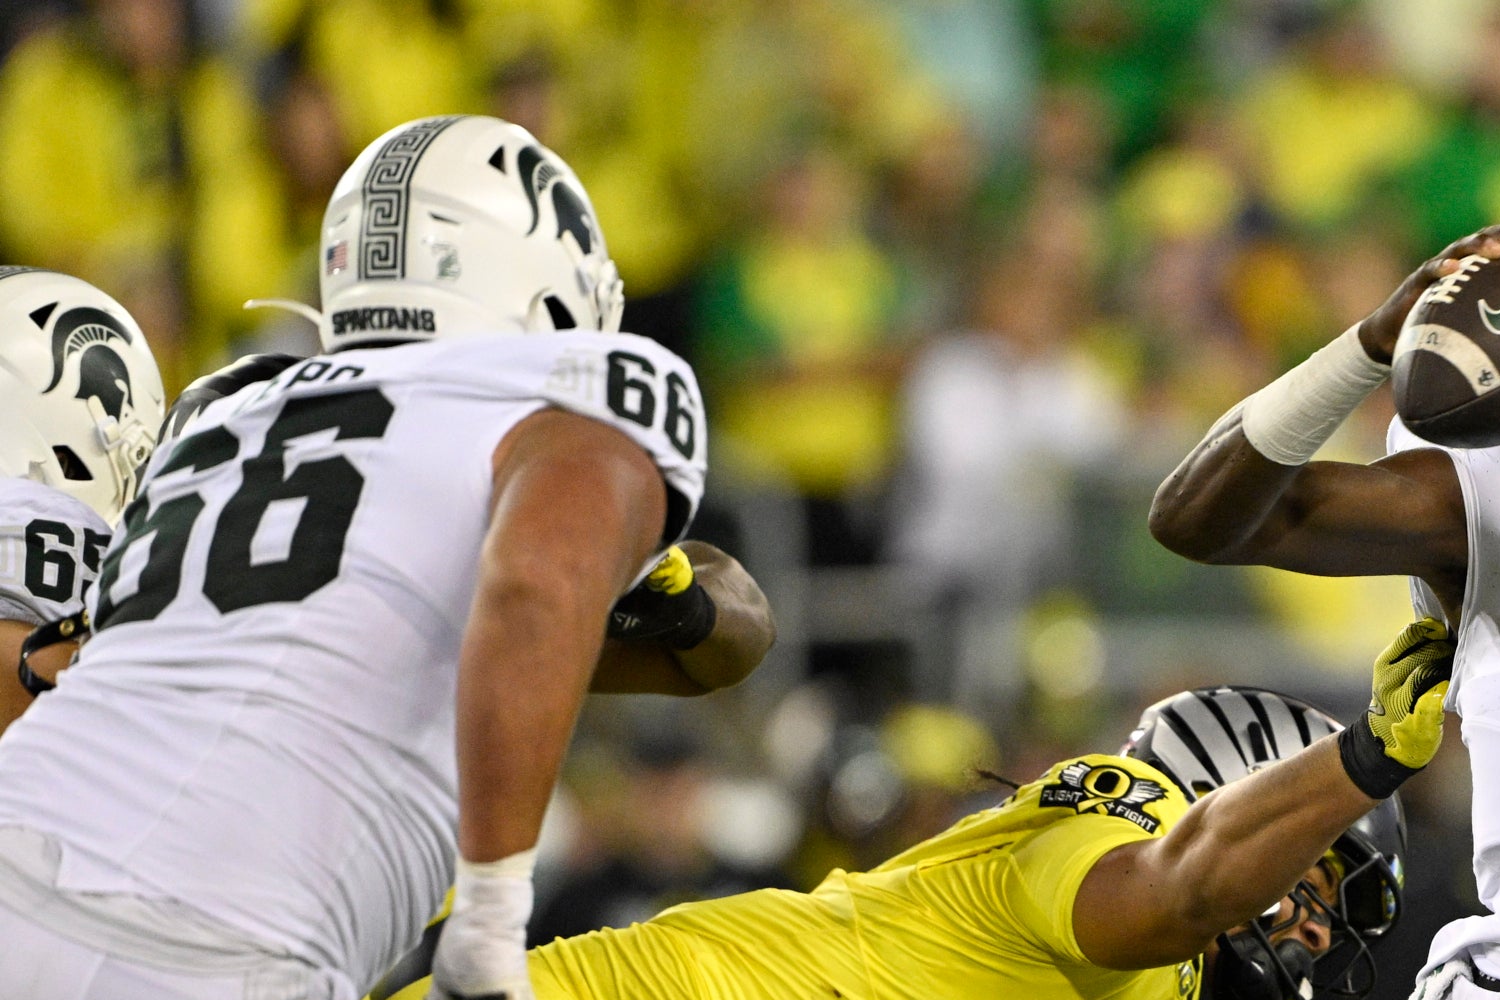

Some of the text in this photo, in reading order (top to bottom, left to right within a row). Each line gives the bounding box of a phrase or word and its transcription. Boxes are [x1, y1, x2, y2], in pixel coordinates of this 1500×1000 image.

[332, 307, 436, 335] SPARTANS
[606, 350, 695, 461] 66
[95, 388, 396, 634] 66
[1042, 789, 1083, 804] FLIGHT
[1115, 804, 1156, 832] FIGHT
